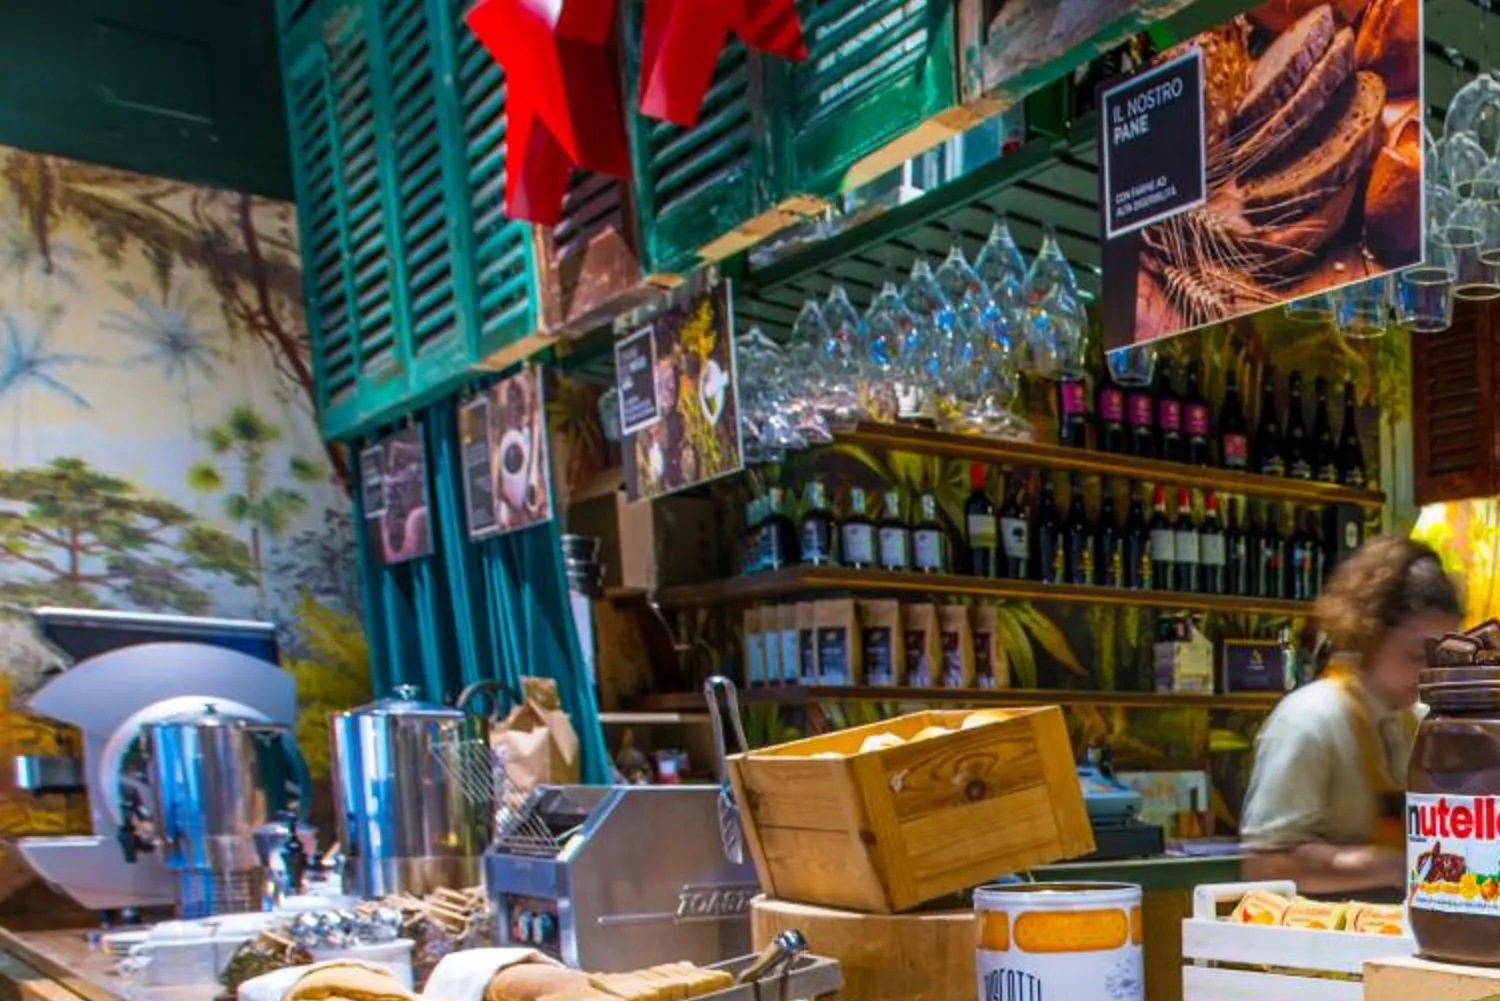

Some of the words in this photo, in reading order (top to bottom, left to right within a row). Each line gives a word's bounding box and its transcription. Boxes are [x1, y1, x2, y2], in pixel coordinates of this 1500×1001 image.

[1113, 105, 1125, 123] IL
[1127, 77, 1183, 115] NOSTRO
[1114, 114, 1149, 144] PANE
